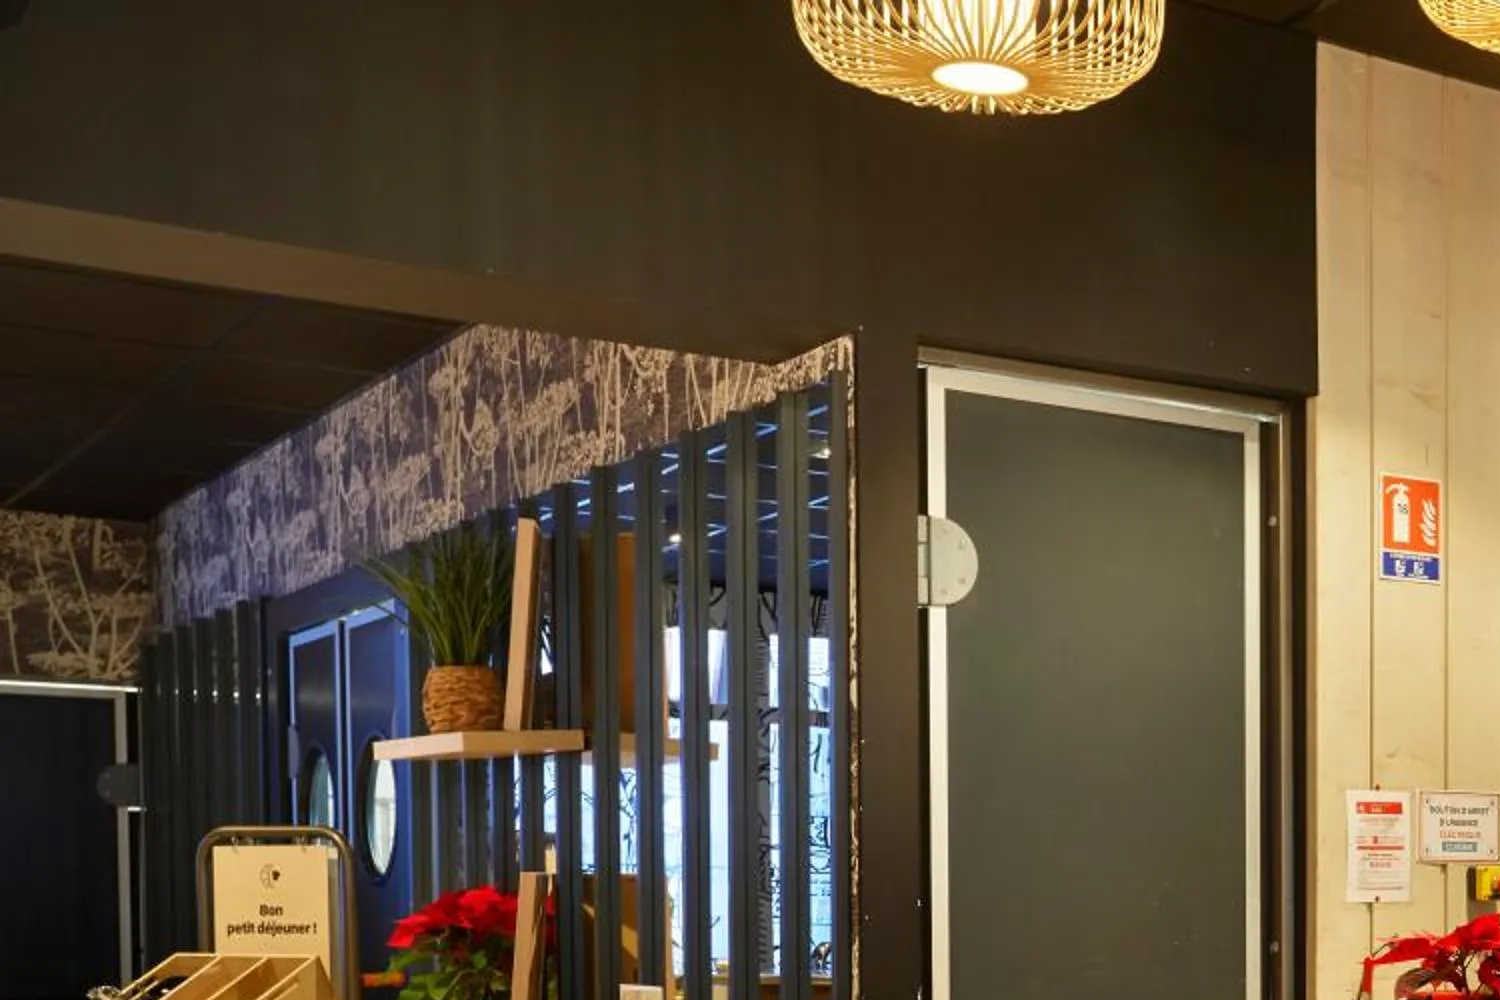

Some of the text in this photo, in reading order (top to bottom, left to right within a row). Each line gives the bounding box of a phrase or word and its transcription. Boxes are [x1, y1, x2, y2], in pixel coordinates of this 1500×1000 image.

[259, 904, 283, 917] Bon
[227, 921, 255, 937] petit
[257, 921, 311, 937] déjeuner
